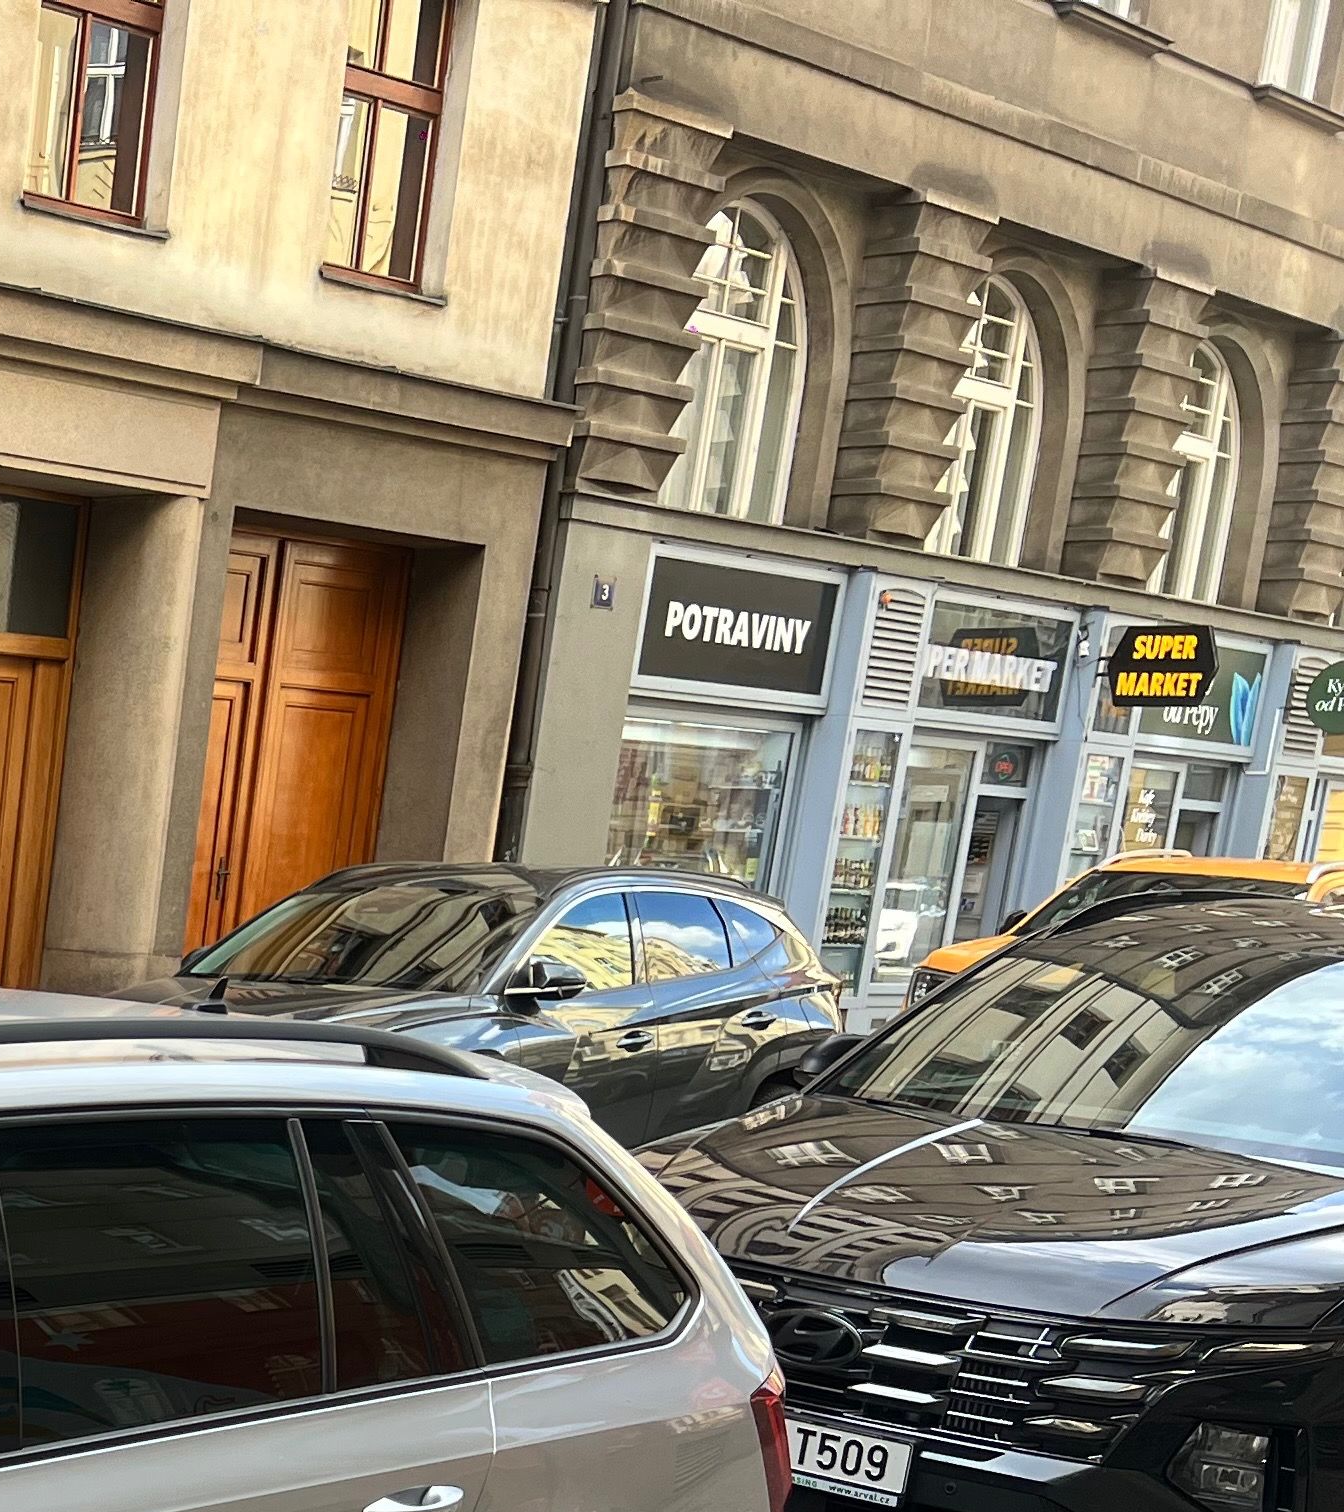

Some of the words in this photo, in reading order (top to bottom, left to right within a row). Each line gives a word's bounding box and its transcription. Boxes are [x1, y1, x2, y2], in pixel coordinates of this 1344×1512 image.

[601, 583, 610, 601] 3
[664, 601, 812, 655] POTRAVINY
[1132, 634, 1199, 660] SUPER
[1115, 672, 1203, 697] MARKET
[797, 1427, 889, 1482] T509
